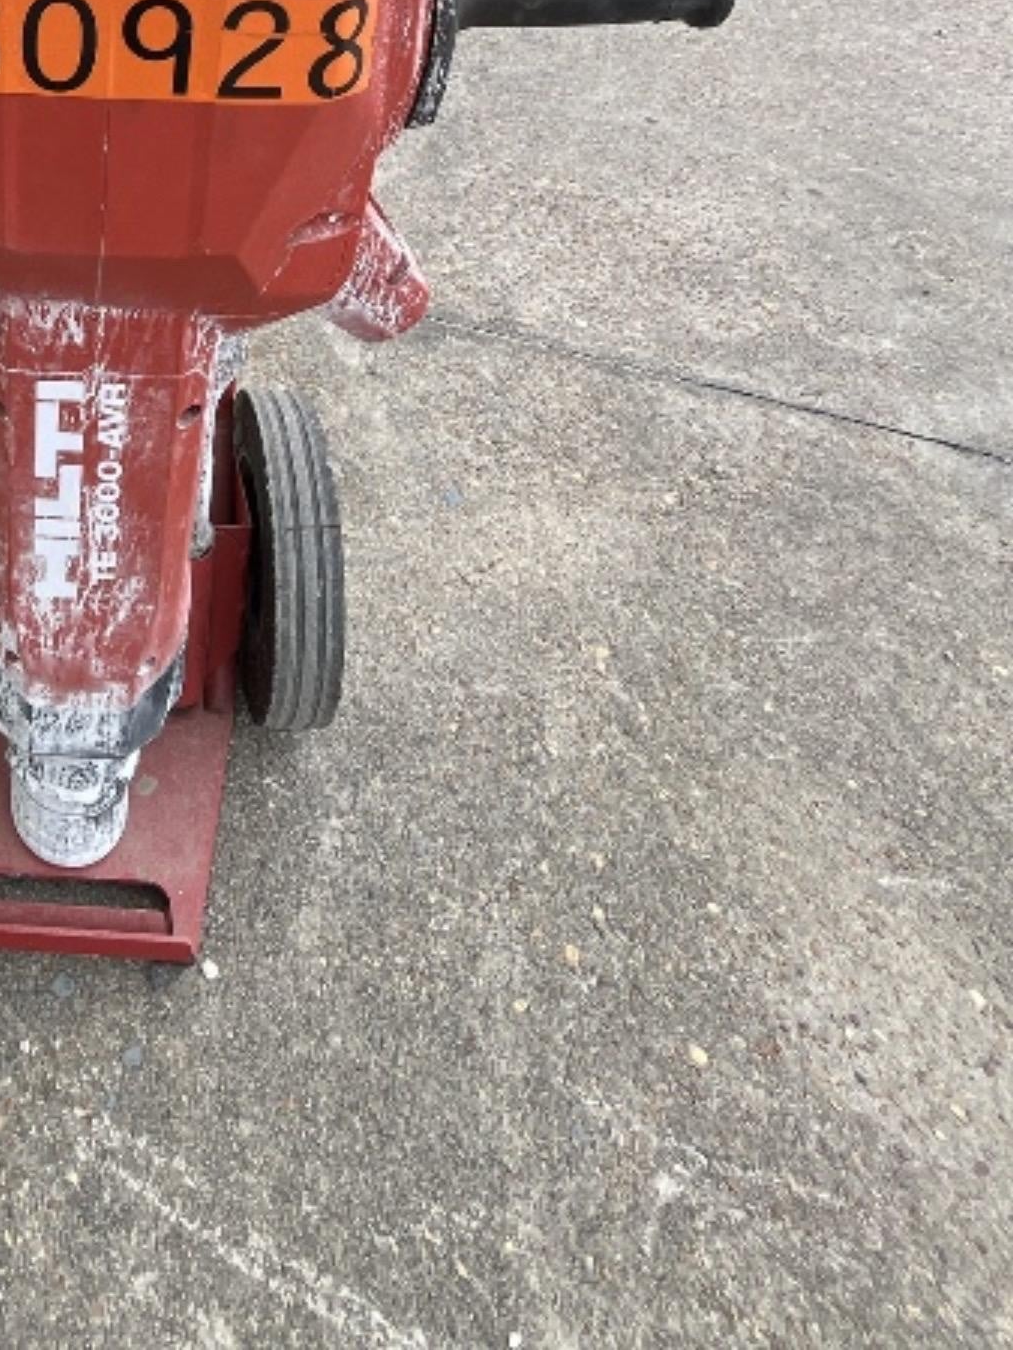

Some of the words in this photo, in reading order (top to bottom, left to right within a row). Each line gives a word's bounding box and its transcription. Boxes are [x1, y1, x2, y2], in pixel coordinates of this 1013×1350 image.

[35, 380, 87, 598] HILTI
[93, 383, 127, 542] 3000-AVR
[91, 551, 117, 581] TE
